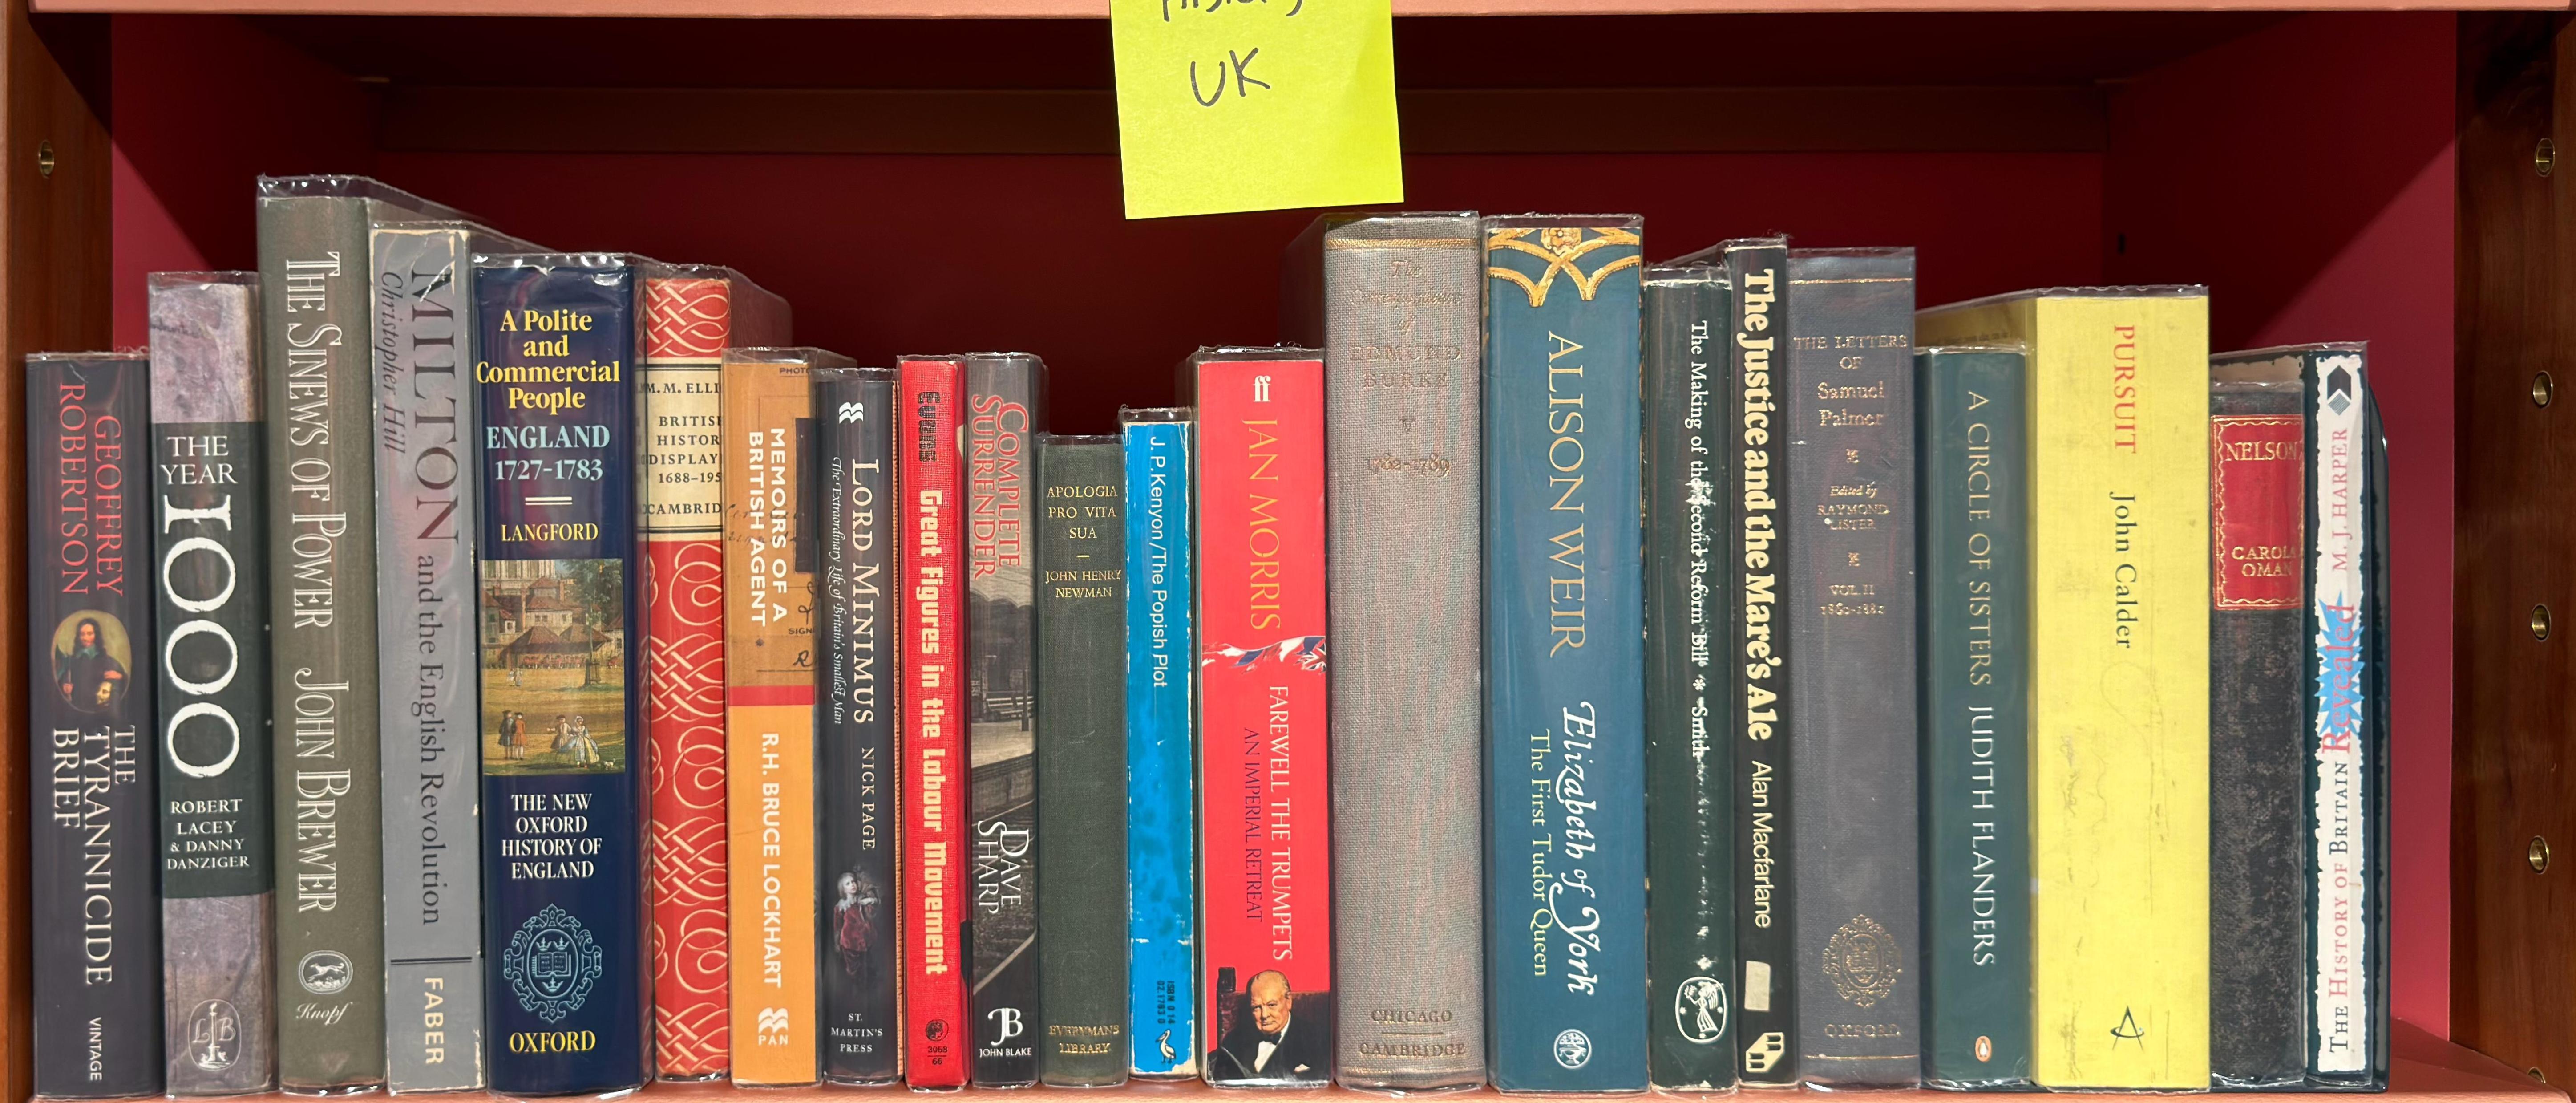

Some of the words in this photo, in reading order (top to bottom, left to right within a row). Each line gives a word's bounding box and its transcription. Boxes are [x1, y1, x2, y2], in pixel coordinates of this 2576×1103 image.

[1190, 48, 1270, 107] UK
[286, 251, 340, 312] THE
[1744, 268, 1775, 331] The
[377, 272, 404, 396] Christopher
[500, 310, 517, 331] A
[524, 309, 592, 332] Polite
[1690, 320, 1708, 355] The
[1793, 336, 1828, 349] THE
[1834, 335, 1908, 349] LETTERS
[523, 335, 569, 357] and
[1839, 357, 1864, 369] OF
[287, 323, 342, 446] SINEWS
[476, 361, 620, 383] Commercial
[1684, 361, 1708, 429] Making
[1737, 333, 1775, 445] Justice
[1817, 381, 1884, 399] Samuel
[2114, 325, 2136, 454] PURSUIT
[411, 268, 459, 544] MILTON
[509, 387, 585, 415] People
[1548, 331, 1585, 514] ALISON
[1819, 408, 1884, 426] Palmer
[1968, 391, 1989, 410] A
[167, 435, 230, 456] THE
[382, 403, 406, 454] Hill
[487, 425, 610, 449] ENGLAND
[1150, 437, 1165, 450] J.
[1241, 420, 1278, 481] JAN
[1690, 436, 1708, 462] of
[2225, 441, 2297, 461] NELSON
[59, 384, 89, 595] ROBERTSON
[161, 464, 238, 485] YEAR
[291, 458, 330, 501] OF
[495, 459, 603, 481] 1727-1783
[749, 432, 764, 529] BRITISH
[770, 428, 787, 549] MEMOIRS
[832, 457, 845, 481] The
[972, 395, 1004, 579] SURRENDER
[996, 403, 1029, 567] COMPLETE
[1047, 486, 1118, 498] APOLOGIA
[1744, 450, 1777, 512] and
[1968, 422, 1990, 521] CIRCLE
[2332, 428, 2347, 517] HARPER
[94, 416, 124, 596] GEOFFREY
[829, 483, 845, 562] Extraordinary
[853, 459, 879, 551] LORD
[920, 491, 942, 556] Great
[1048, 507, 1077, 519] PRO
[1086, 506, 1116, 518] VITA
[2109, 491, 2137, 553] John
[501, 523, 598, 541] LANGFORD
[1069, 527, 1097, 539] SUA
[1745, 514, 1776, 569] the
[1968, 533, 1990, 570] OF
[2332, 526, 2352, 539] J.
[291, 512, 347, 629] POWER
[417, 555, 444, 604] and
[750, 539, 765, 626] AGENT
[772, 562, 787, 593] OF
[827, 565, 846, 584] Life
[1045, 571, 1078, 584] JOHN
[1082, 569, 1121, 580] HENRY
[1249, 494, 1281, 630] MORRIS
[2332, 547, 2347, 571] M.
[772, 604, 787, 621] A
[829, 585, 846, 602] of
[916, 567, 943, 654] Figures
[1055, 588, 1112, 598] NEWMAN
[1549, 523, 1585, 659] WEIR
[1690, 561, 1709, 625] Reform
[2115, 563, 2139, 649] Calder
[419, 613, 444, 654] the
[833, 603, 847, 649] Britain's
[1149, 590, 1168, 646] Popish
[1745, 574, 1782, 679] Mare's
[1969, 580, 1991, 686] SISTERS
[853, 562, 880, 723] MINIMUS
[1691, 632, 1709, 661] Bill
[834, 653, 847, 697] Smallest
[921, 665, 944, 687] in
[1153, 653, 1168, 688] Plot
[2321, 604, 2354, 754] Revealed
[294, 668, 349, 759] JOHN
[411, 662, 445, 763] English
[831, 693, 844, 724] Man
[922, 697, 942, 738] the
[1747, 684, 1779, 742] Ale
[115, 724, 136, 784] THE
[1244, 728, 1260, 756] AN
[1269, 686, 1292, 792] FAREWELL
[1530, 729, 1550, 772] The
[1969, 706, 1994, 810] JUDITH
[53, 729, 80, 828] BRIEF
[862, 747, 875, 795] NICK
[922, 748, 945, 832] Labour
[1555, 701, 1596, 859] Elizabeth
[1752, 760, 1772, 806] Alan
[170, 799, 243, 814] ROBERT
[511, 794, 546, 811] THE
[552, 794, 592, 810] NEW
[516, 816, 587, 833] OXFORD
[763, 782, 780, 858] BRUCE
[862, 802, 875, 850] PAGE
[1245, 763, 1261, 842] IMPERIAL
[1270, 798, 1291, 841] THE
[1531, 779, 1551, 827] First
[2329, 762, 2349, 855] BRITAIN
[170, 841, 180, 852] &
[186, 839, 245, 853] DANNY
[178, 821, 236, 835] LACEY
[296, 768, 351, 913] BREWER
[420, 772, 447, 925] Revolution
[502, 838, 577, 856] HISTORY
[580, 838, 602, 855] OF
[84, 724, 113, 985] TYRANNICIDE
[167, 856, 250, 870] DANZIGER
[511, 860, 594, 879] ENGLAND
[978, 820, 1006, 914] SHARP
[999, 829, 1029, 906] DAVE
[1532, 834, 1553, 901] Tudor
[1752, 813, 1775, 928] Macfarlane
[2335, 863, 2349, 888] OF
[1246, 848, 1263, 922] RETREAT
[1271, 848, 1293, 960] TRUMPETS
[1561, 868, 1596, 898] of
[1973, 823, 1996, 966] FLANDERS
[763, 864, 781, 989] LOCKHART
[1530, 909, 1553, 977] Queen
[1549, 882, 1601, 996] York
[2329, 896, 2349, 998] HISTORY
[296, 1002, 349, 1026] Knopf
[424, 977, 445, 1065] FABER
[831, 1027, 883, 1037] MARTIN'S
[849, 1013, 863, 1022] ST.
[1371, 1010, 1452, 1022] CHICAGO
[1825, 1023, 1901, 1037] OXFORD
[2329, 1005, 2349, 1053] THE
[89, 1017, 102, 1081] VINTAGE
[509, 1030, 596, 1052] OXFORD
[758, 1035, 789, 1045] PAN
[840, 1043, 873, 1053] PRESS
[979, 1047, 1003, 1058] JOHN
[1006, 1047, 1031, 1056] BLAKE
[1359, 1043, 1466, 1057] CAMBRIDGE
